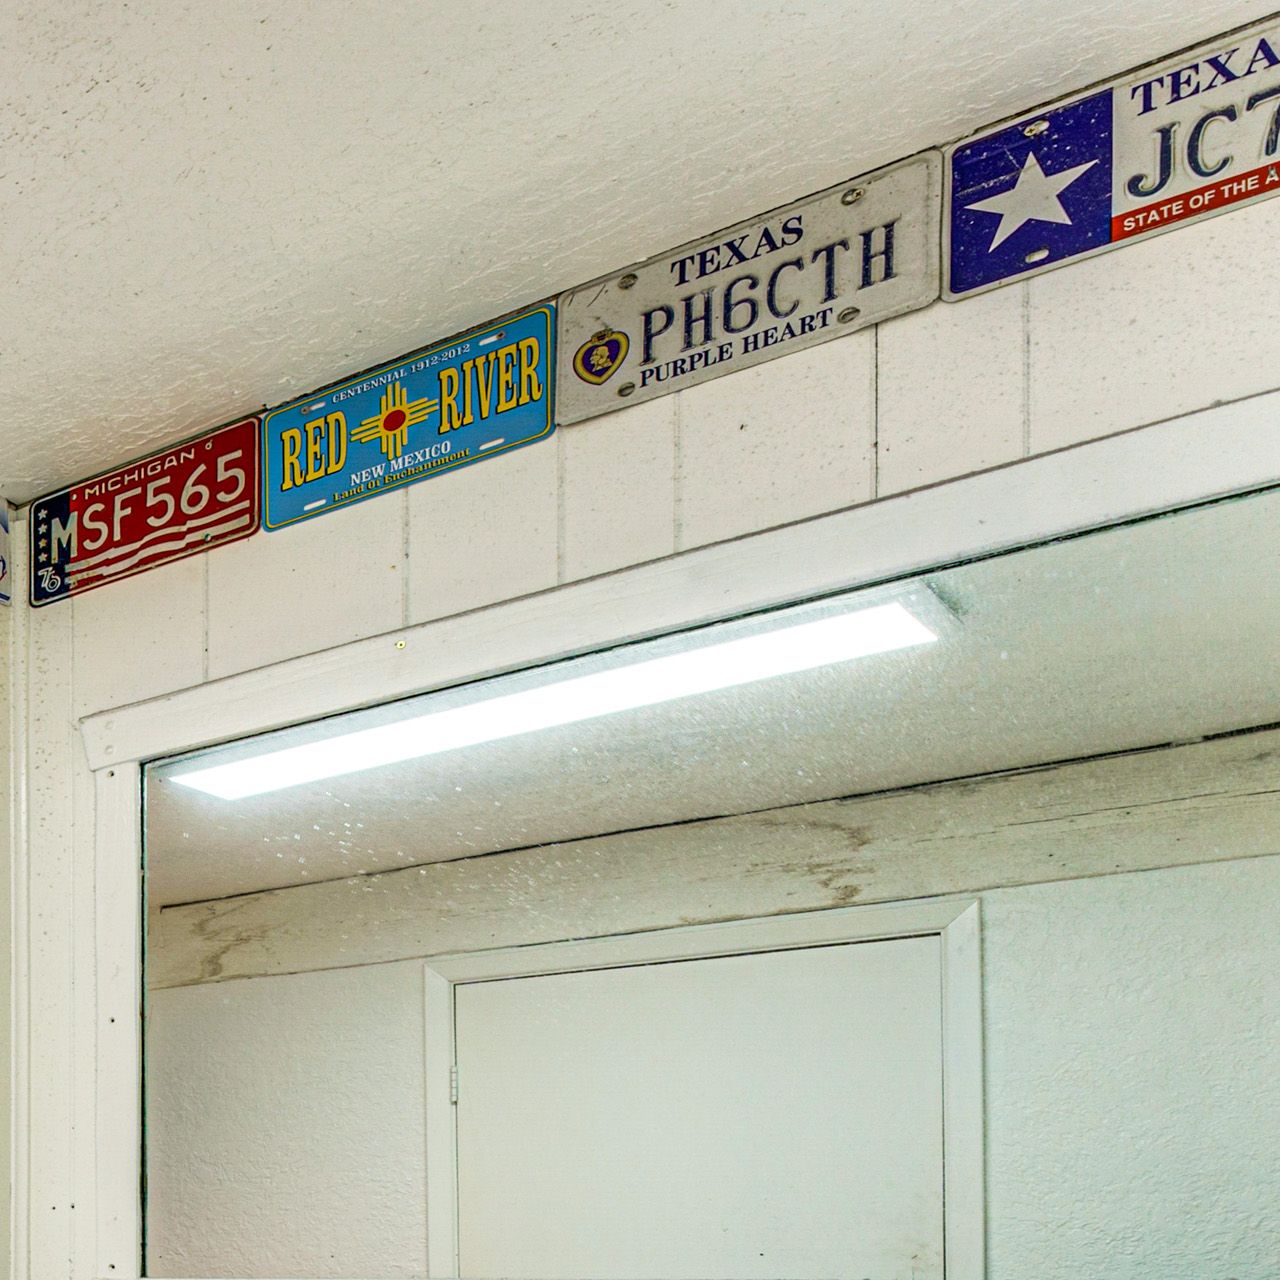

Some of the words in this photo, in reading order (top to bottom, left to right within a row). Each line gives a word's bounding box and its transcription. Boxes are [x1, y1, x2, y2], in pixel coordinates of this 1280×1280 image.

[1131, 37, 1280, 116] TEXA
[1123, 203, 1184, 232] STATE
[1189, 190, 1216, 209] OF
[1220, 175, 1260, 198] THE
[1265, 166, 1280, 186] A
[671, 215, 804, 287] TEXAS
[640, 219, 901, 367] PH6CTH
[331, 368, 408, 404] CENTENNIAL
[409, 343, 471, 374] 1912-2012
[639, 341, 734, 388] PURPLE
[741, 307, 834, 355] HEART
[280, 409, 348, 492] RED
[437, 335, 544, 435] RIVER
[84, 447, 195, 500] MICHIGAN
[332, 483, 365, 502] Land
[383, 447, 471, 485] Enchantment
[349, 462, 386, 487] NEW
[389, 440, 452, 473] MEXICO
[38, 566, 61, 593] 76
